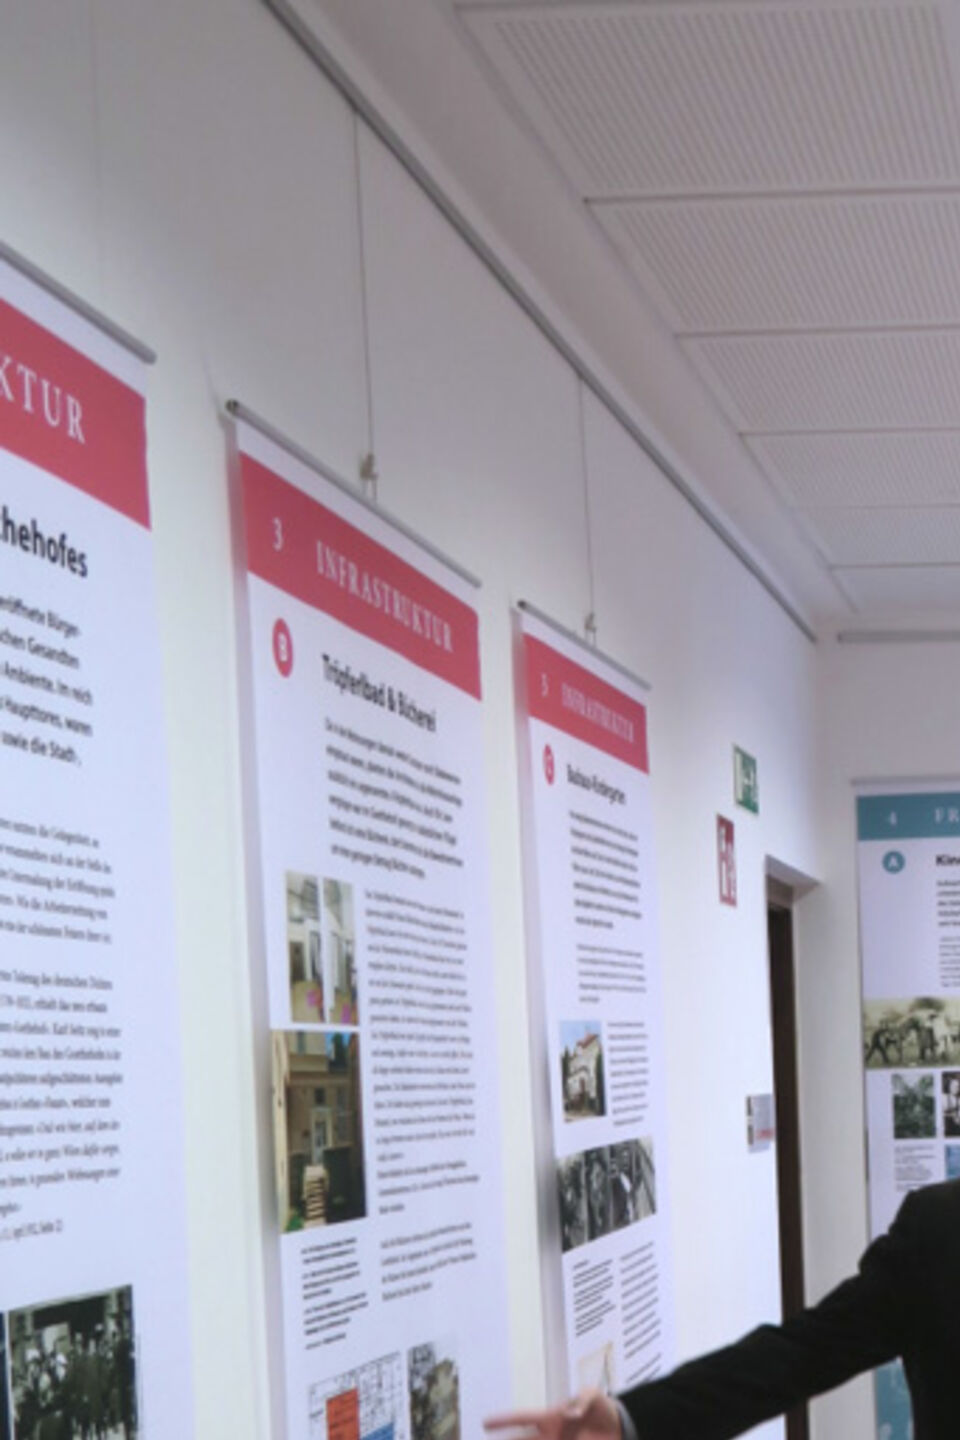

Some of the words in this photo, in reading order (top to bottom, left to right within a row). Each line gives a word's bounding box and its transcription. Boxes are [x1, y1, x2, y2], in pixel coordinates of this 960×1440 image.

[0, 503, 88, 578] hehofes
[273, 516, 284, 552] 3
[316, 540, 454, 654] INFRASTRUKTUR
[888, 855, 898, 869] A
